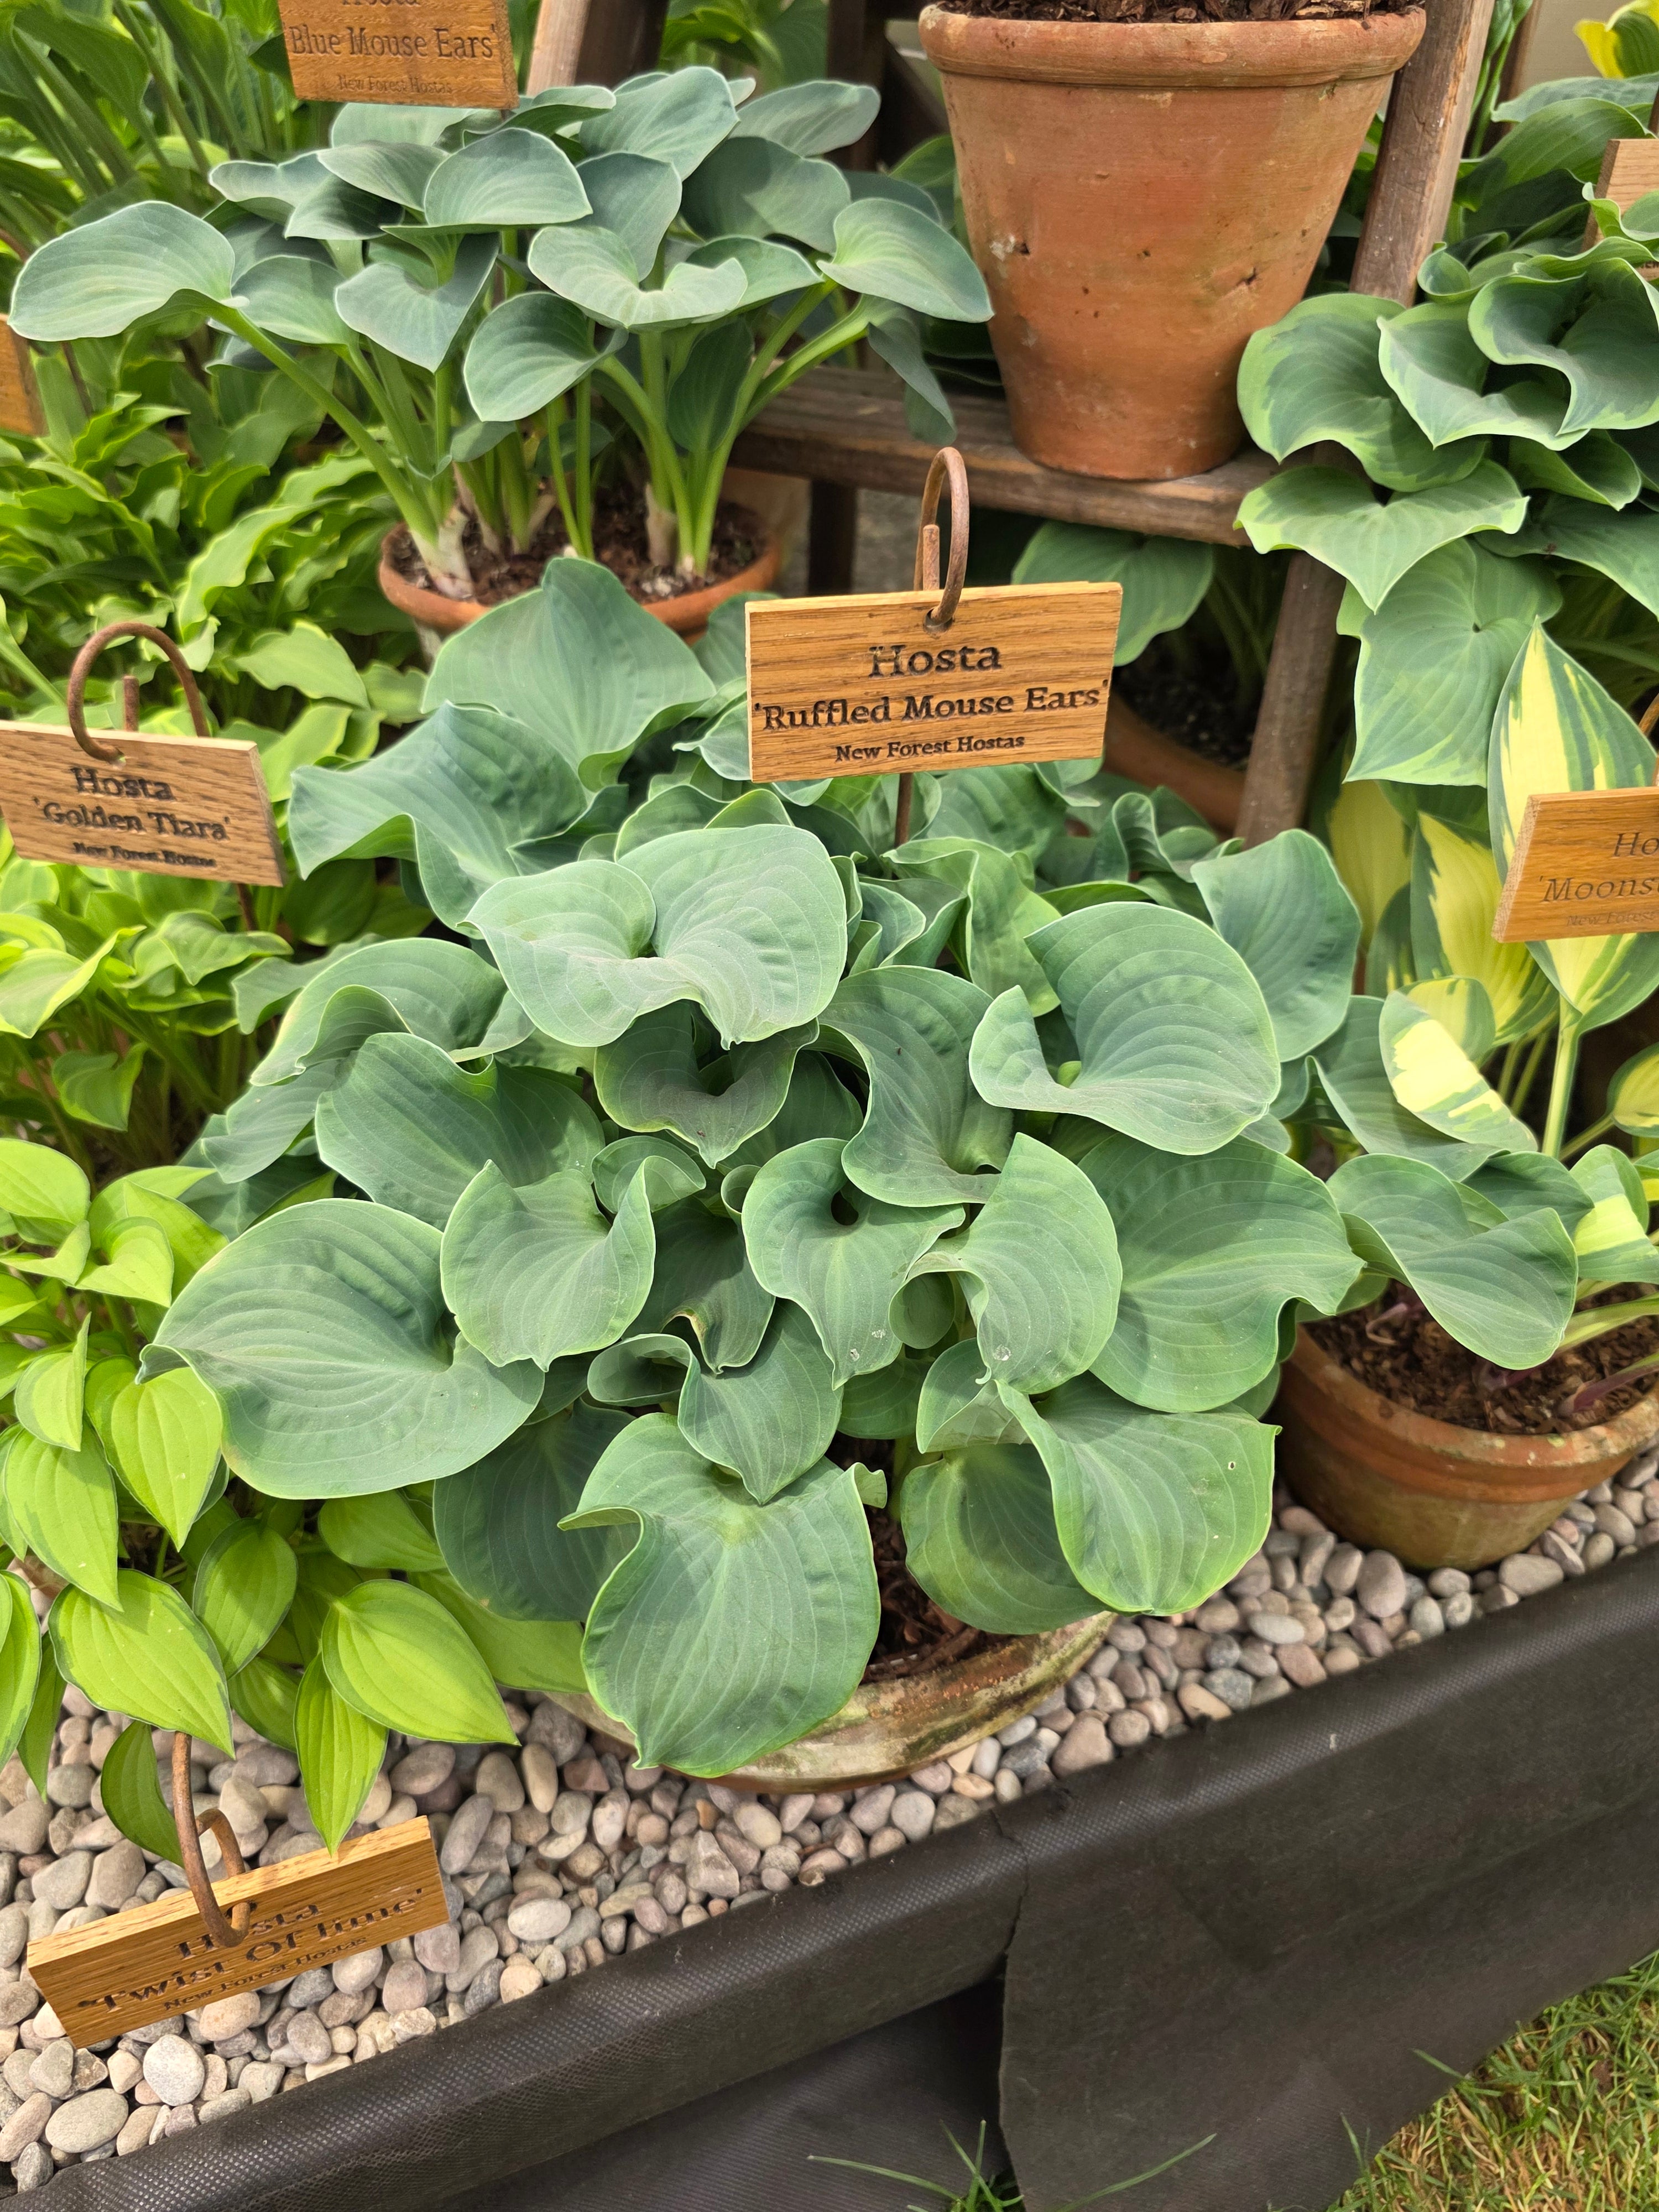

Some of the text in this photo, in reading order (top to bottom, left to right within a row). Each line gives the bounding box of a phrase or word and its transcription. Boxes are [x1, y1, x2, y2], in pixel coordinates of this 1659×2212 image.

[347, 27, 427, 57] Mouse
[434, 24, 496, 58] Ears'
[409, 77, 453, 93] Hostas
[868, 643, 1002, 679] Hosta
[754, 679, 1109, 731] 'Ruffled Mouse Ears'
[836, 735, 1025, 762] New Forest Hostas
[70, 767, 176, 802] Hosta
[33, 796, 231, 841] 'Golden Tiara'
[1539, 875, 1659, 902] 'Moons
[174, 1903, 321, 1959] Hsta
[245, 1930, 303, 1963] Of
[164, 1937, 367, 2011] New Forest Hostas
